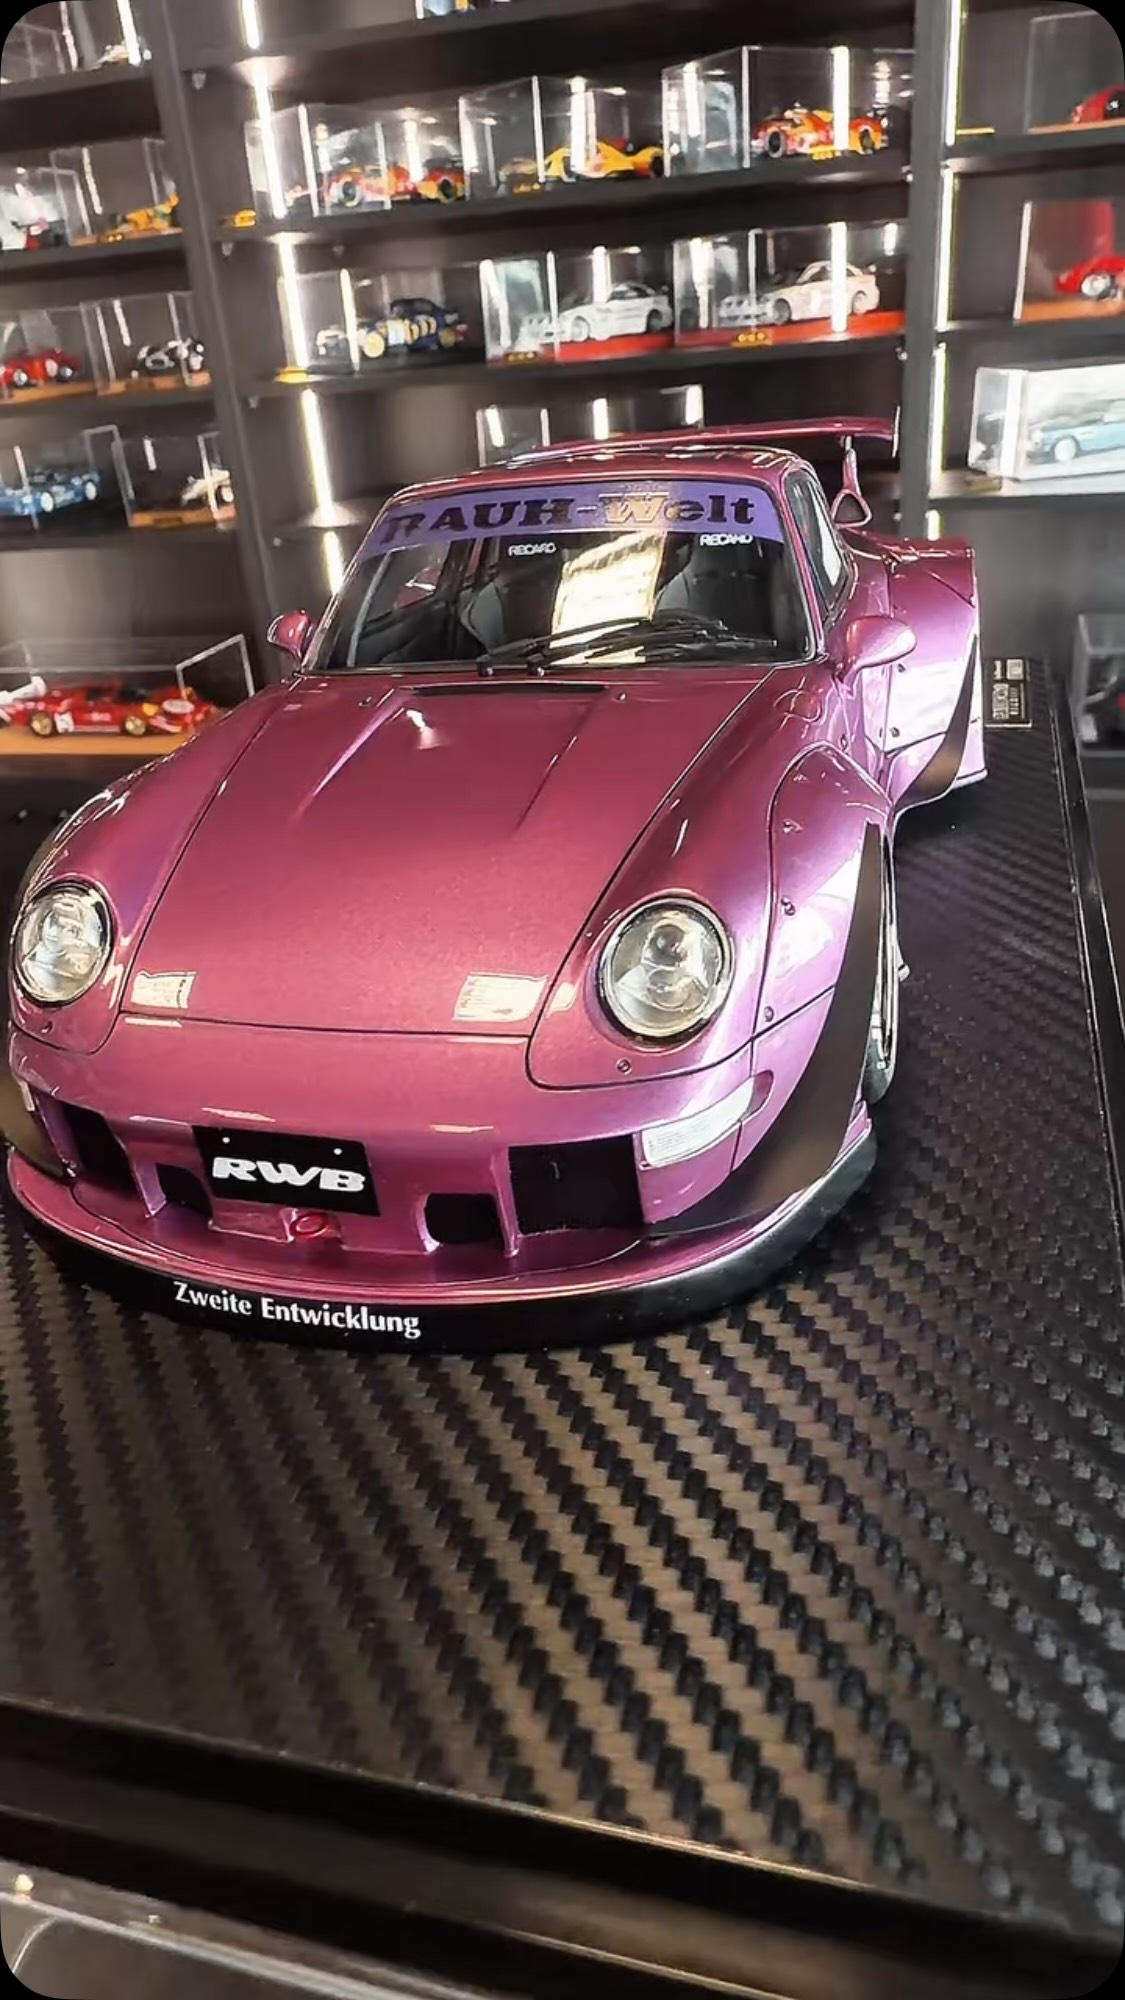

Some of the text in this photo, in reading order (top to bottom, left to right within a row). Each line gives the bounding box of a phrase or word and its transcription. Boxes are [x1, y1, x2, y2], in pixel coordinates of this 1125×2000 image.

[380, 492, 755, 544] RAUH-Welt
[212, 1156, 365, 1192] RWB
[173, 1280, 421, 1339] Zweite Entwicklung
